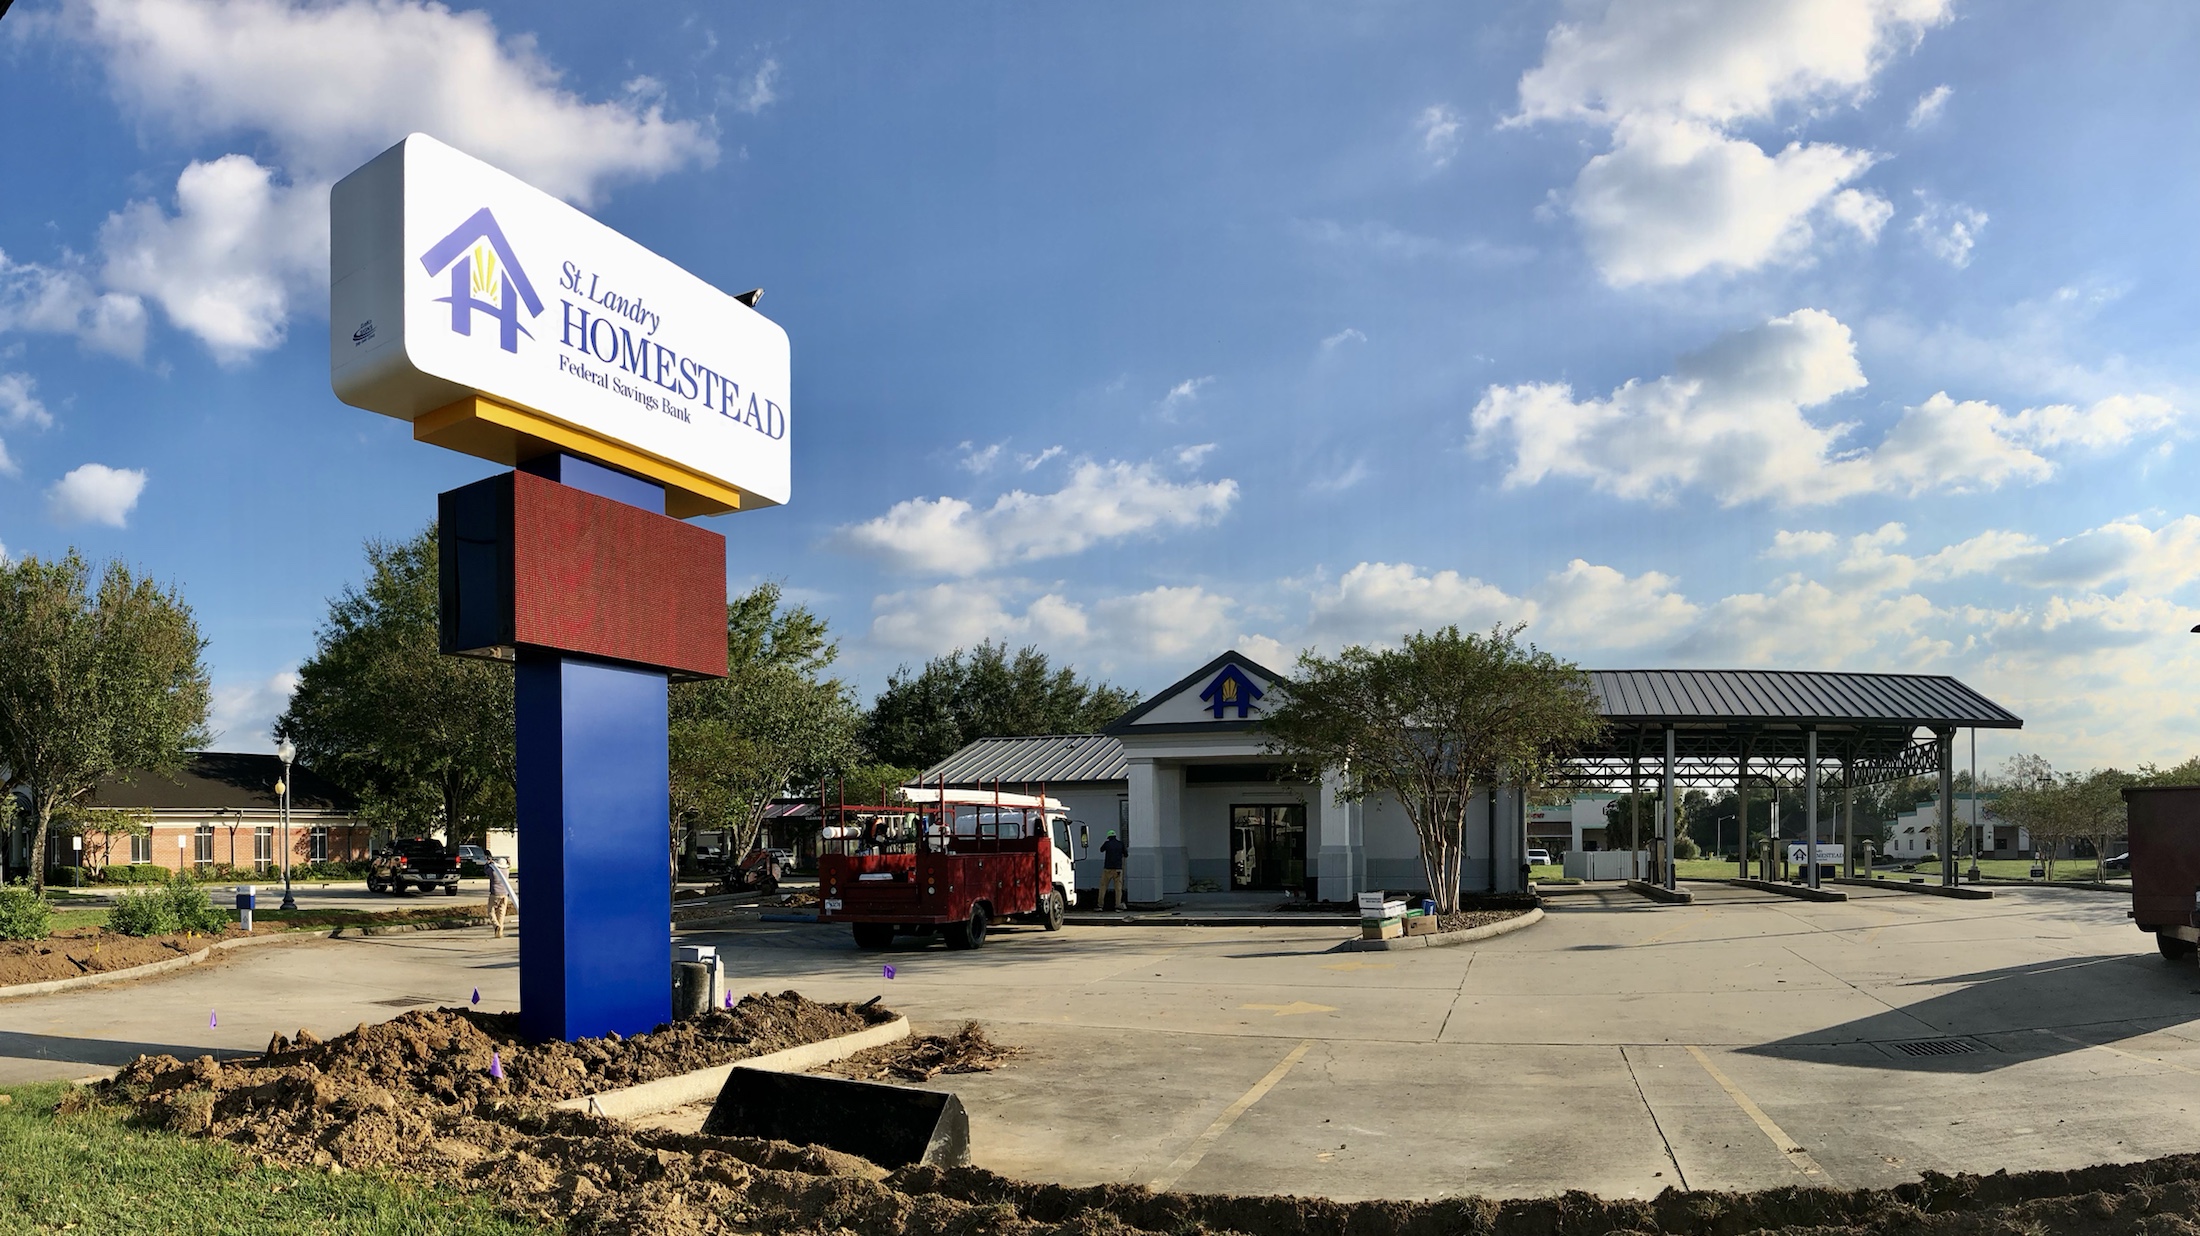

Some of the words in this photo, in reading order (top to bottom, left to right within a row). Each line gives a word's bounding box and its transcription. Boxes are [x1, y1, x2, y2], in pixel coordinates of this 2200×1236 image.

[560, 260, 584, 296] St.
[587, 272, 661, 336] Landry
[558, 353, 609, 389] Federal
[612, 376, 659, 411] Savings
[661, 397, 692, 425] Bank
[559, 298, 786, 441] HOMESTEAD
